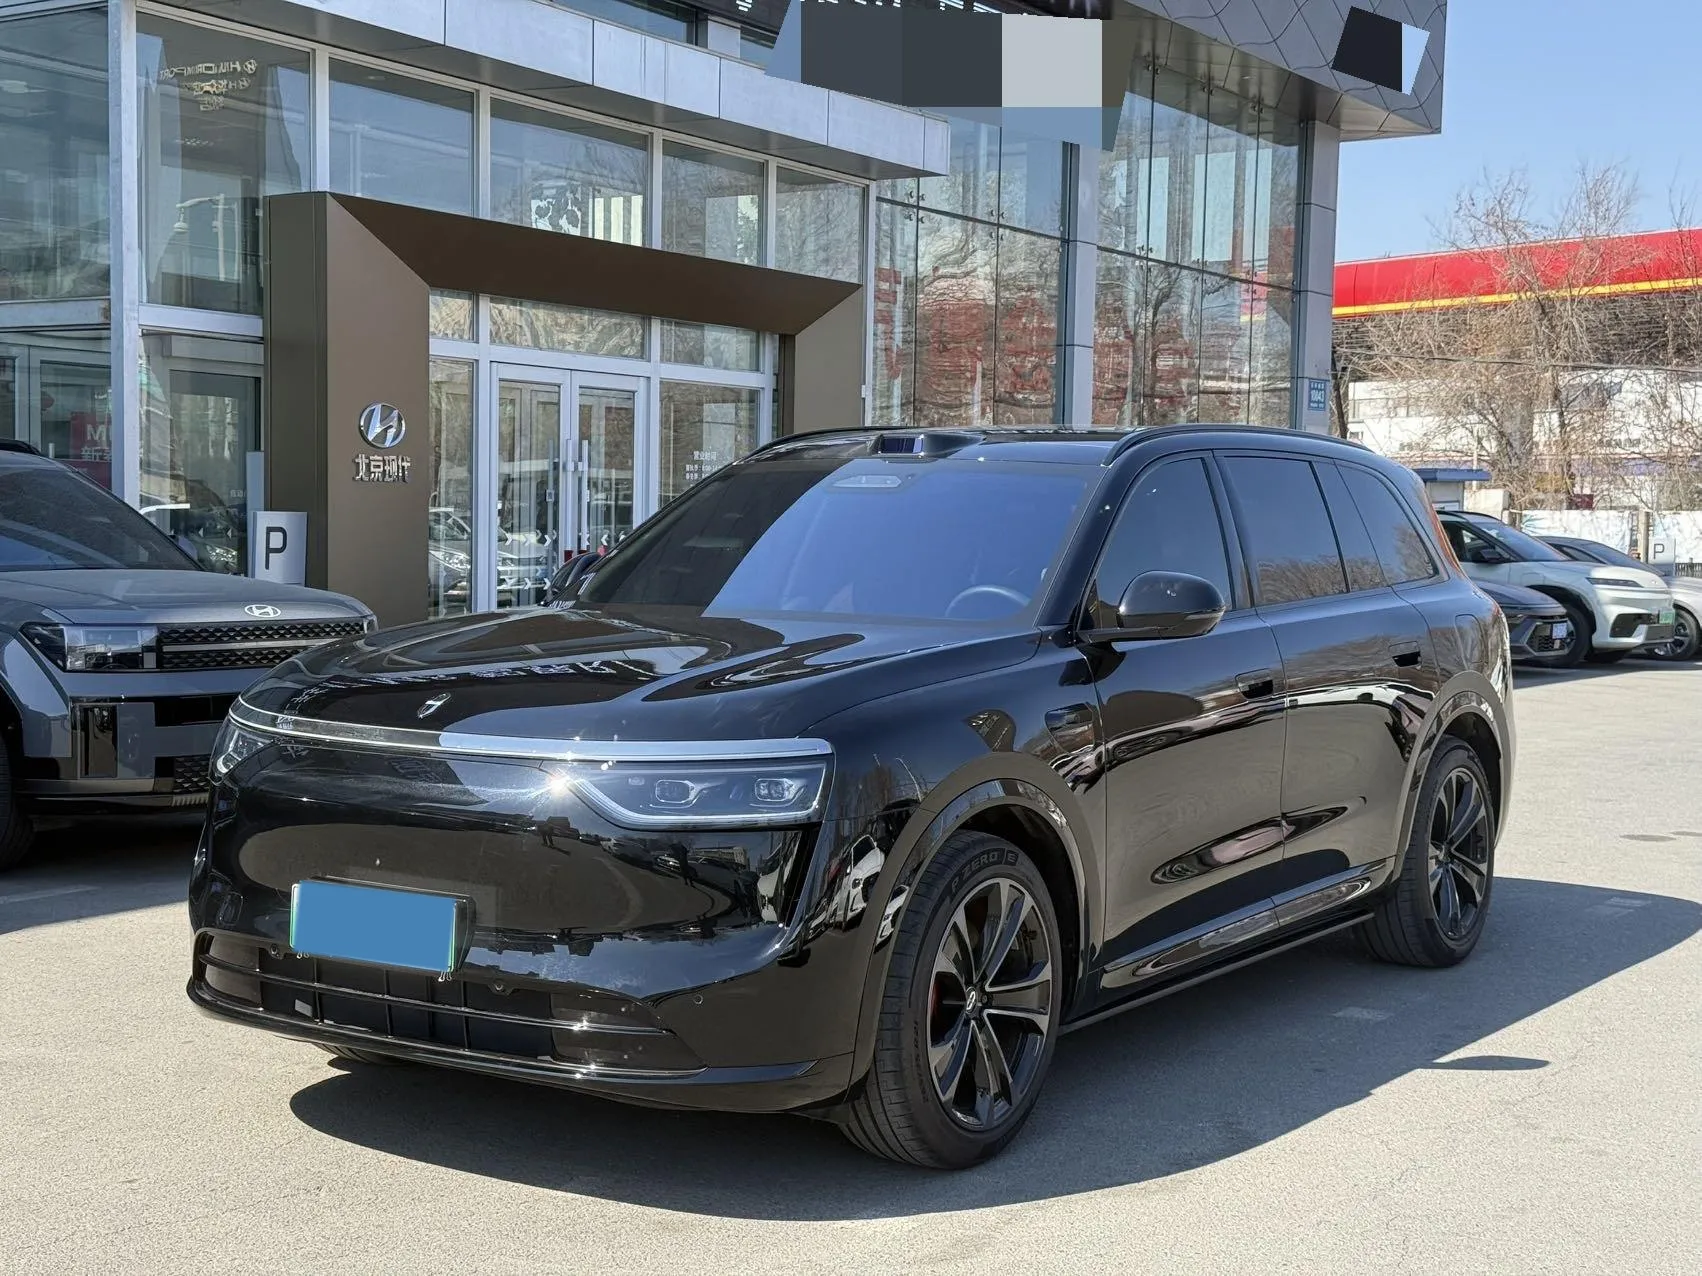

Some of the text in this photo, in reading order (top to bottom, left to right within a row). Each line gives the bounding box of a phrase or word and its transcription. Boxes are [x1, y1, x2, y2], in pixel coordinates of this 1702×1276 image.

[354, 453, 411, 482] 北京现代
[265, 526, 288, 570] P
[1653, 543, 1666, 560] P
[951, 876, 961, 894] P
[962, 851, 999, 881] ZERO
